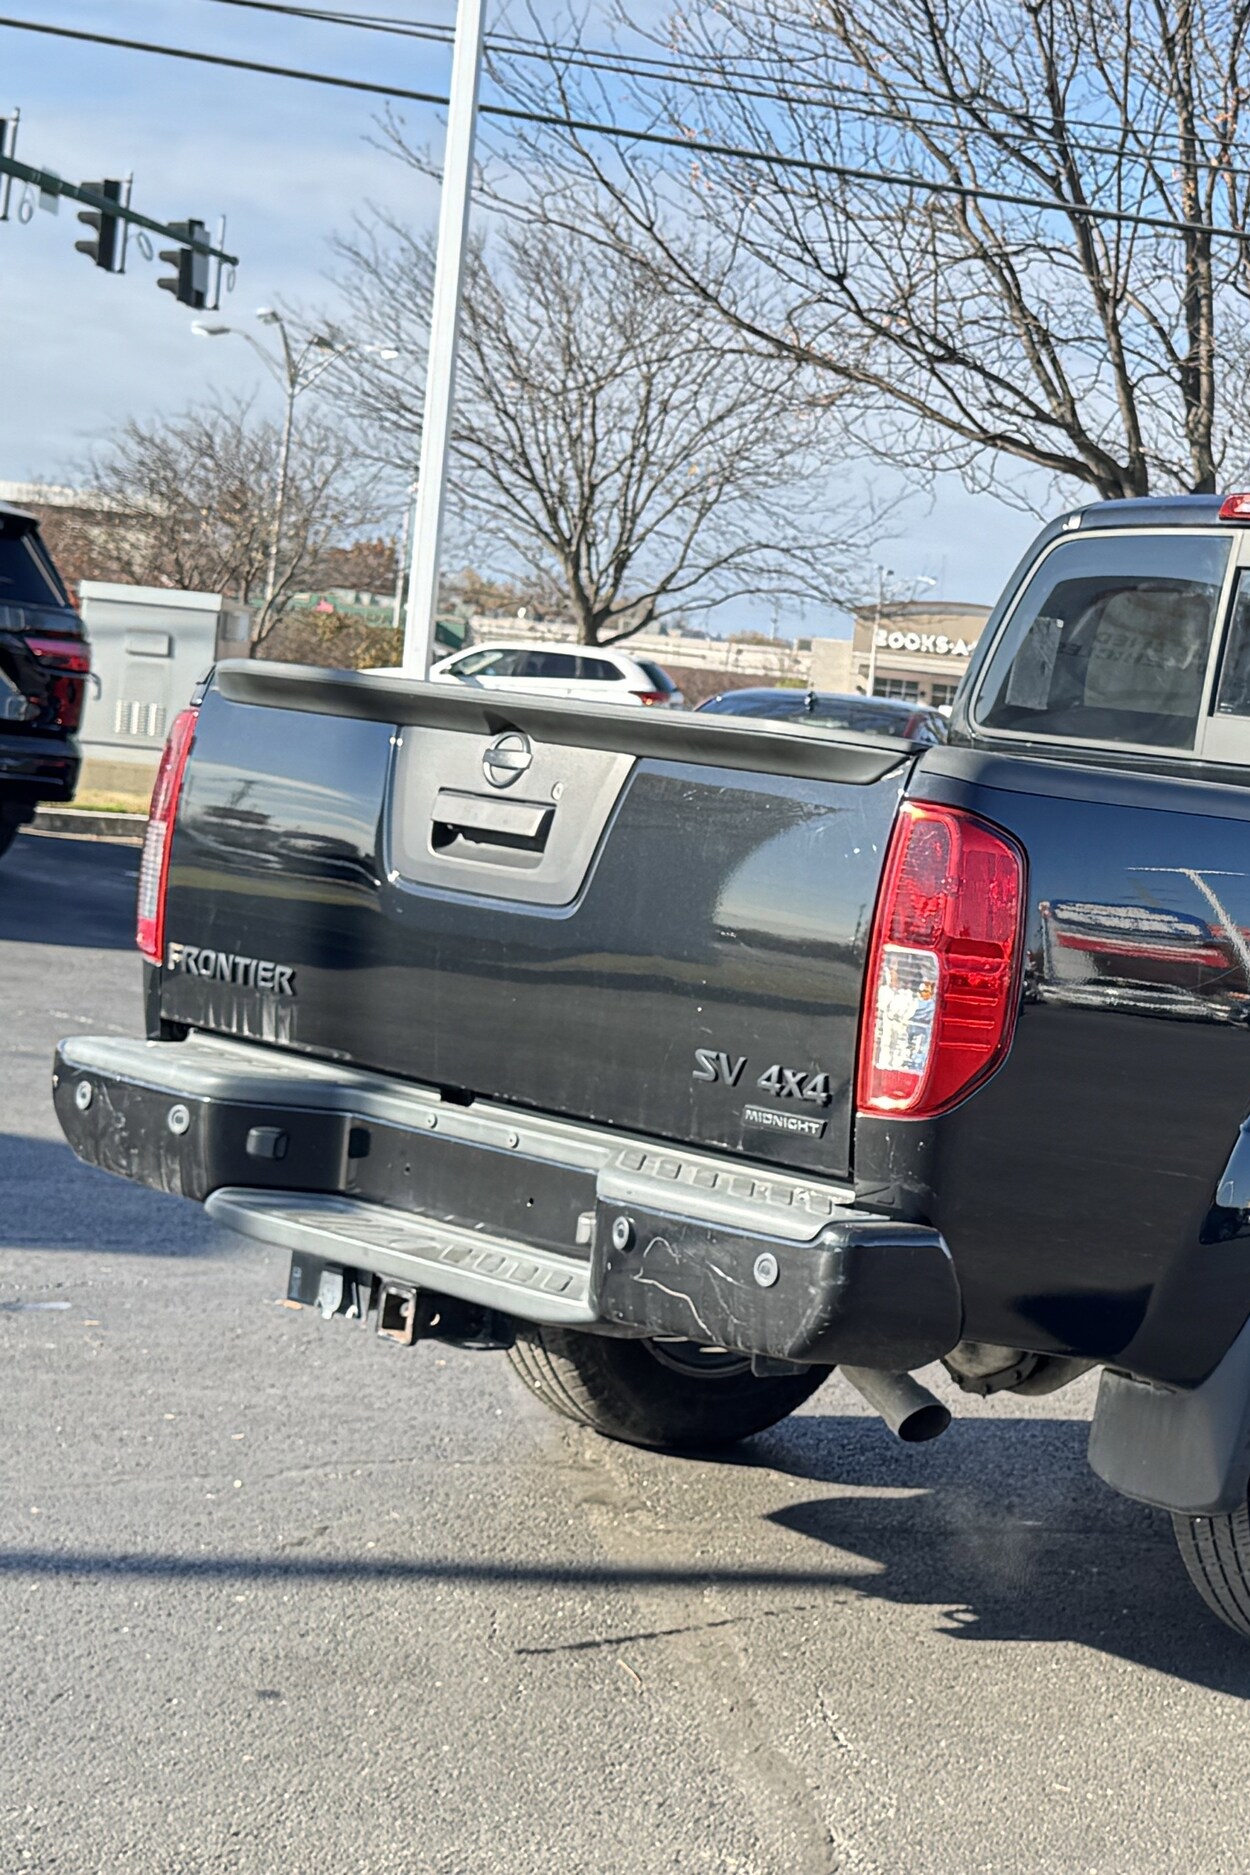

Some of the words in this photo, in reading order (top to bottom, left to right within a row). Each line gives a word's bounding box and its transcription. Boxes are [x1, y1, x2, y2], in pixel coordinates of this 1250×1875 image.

[167, 941, 296, 996] FRONTIER
[692, 1048, 748, 1087] SV
[744, 1108, 820, 1135] MIDNIGHT
